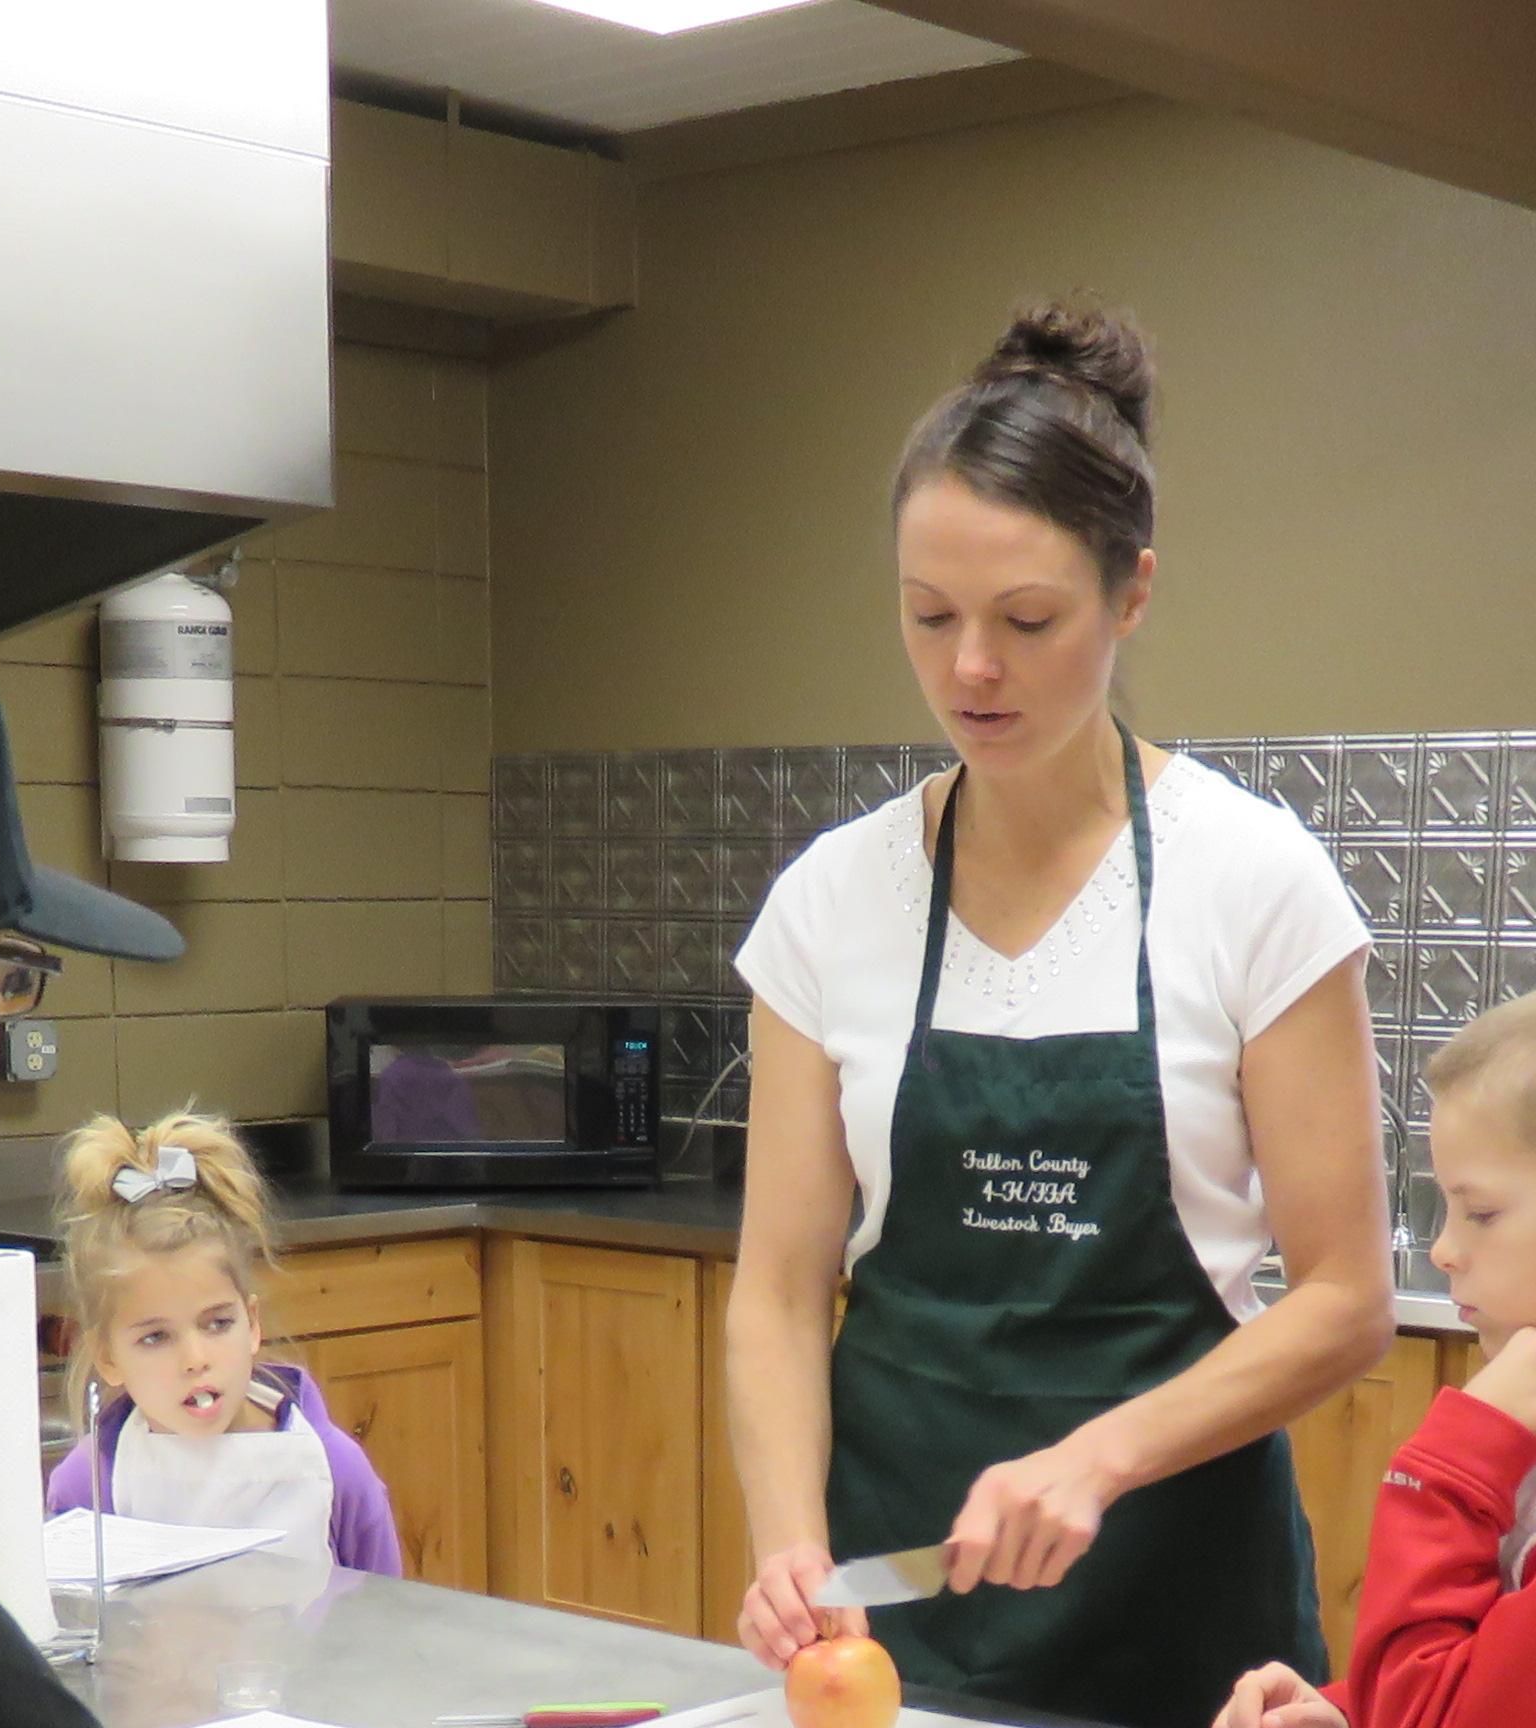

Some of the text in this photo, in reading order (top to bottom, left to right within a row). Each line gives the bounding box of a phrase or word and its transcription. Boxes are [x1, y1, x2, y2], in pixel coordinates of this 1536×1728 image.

[962, 1149, 1092, 1179] Fallon County
[982, 1179, 1078, 1204] 4-H/FFA
[962, 1207, 1101, 1241] Livestock Buyer
